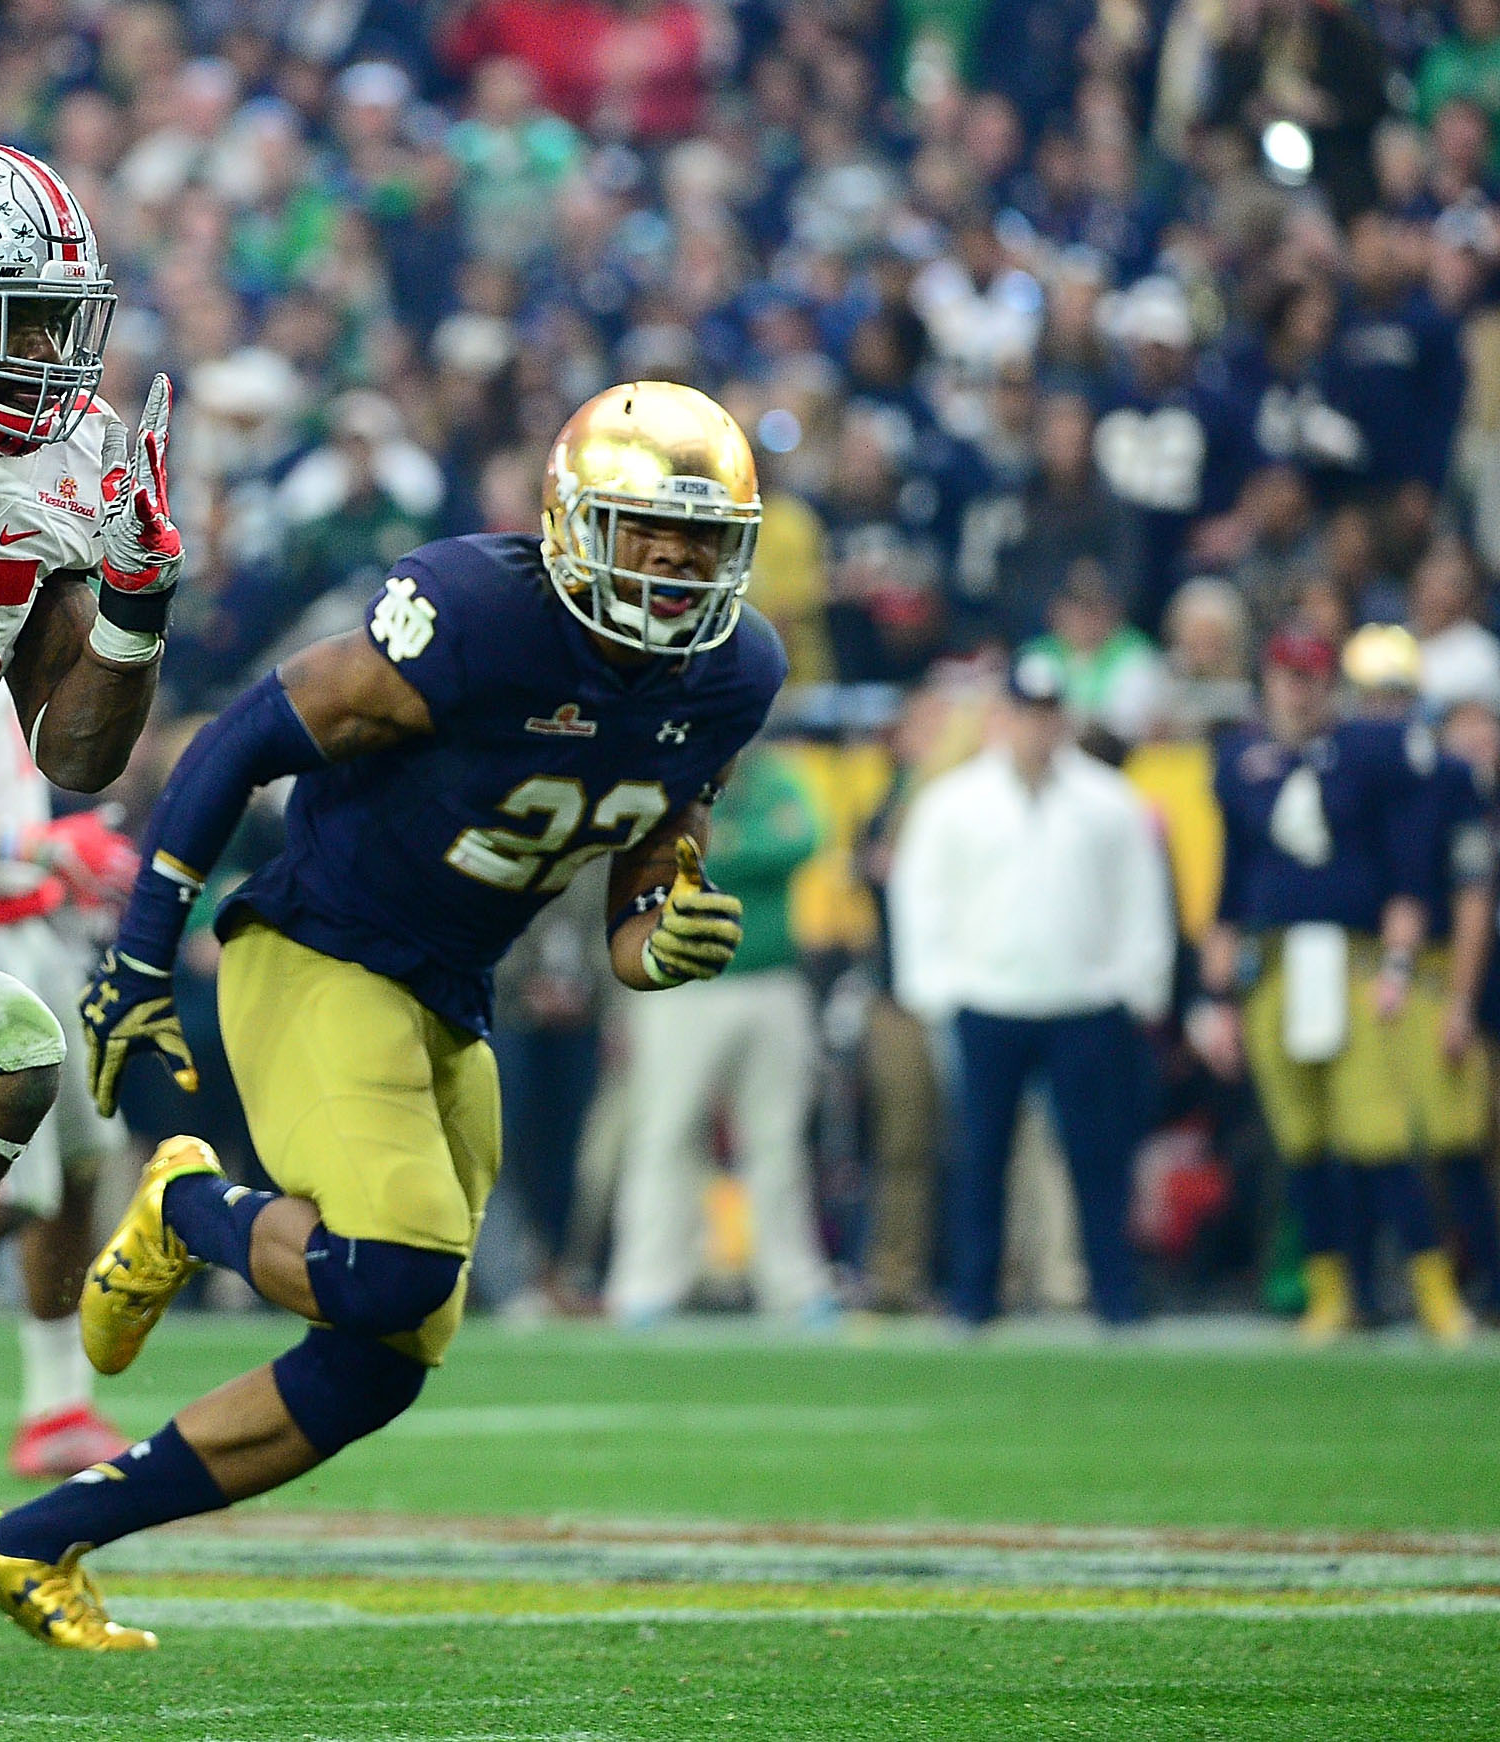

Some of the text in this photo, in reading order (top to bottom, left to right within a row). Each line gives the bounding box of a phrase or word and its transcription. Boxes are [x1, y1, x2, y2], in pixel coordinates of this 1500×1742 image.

[37, 490, 96, 519] Fiesta Bowl
[443, 773, 670, 893] 22
